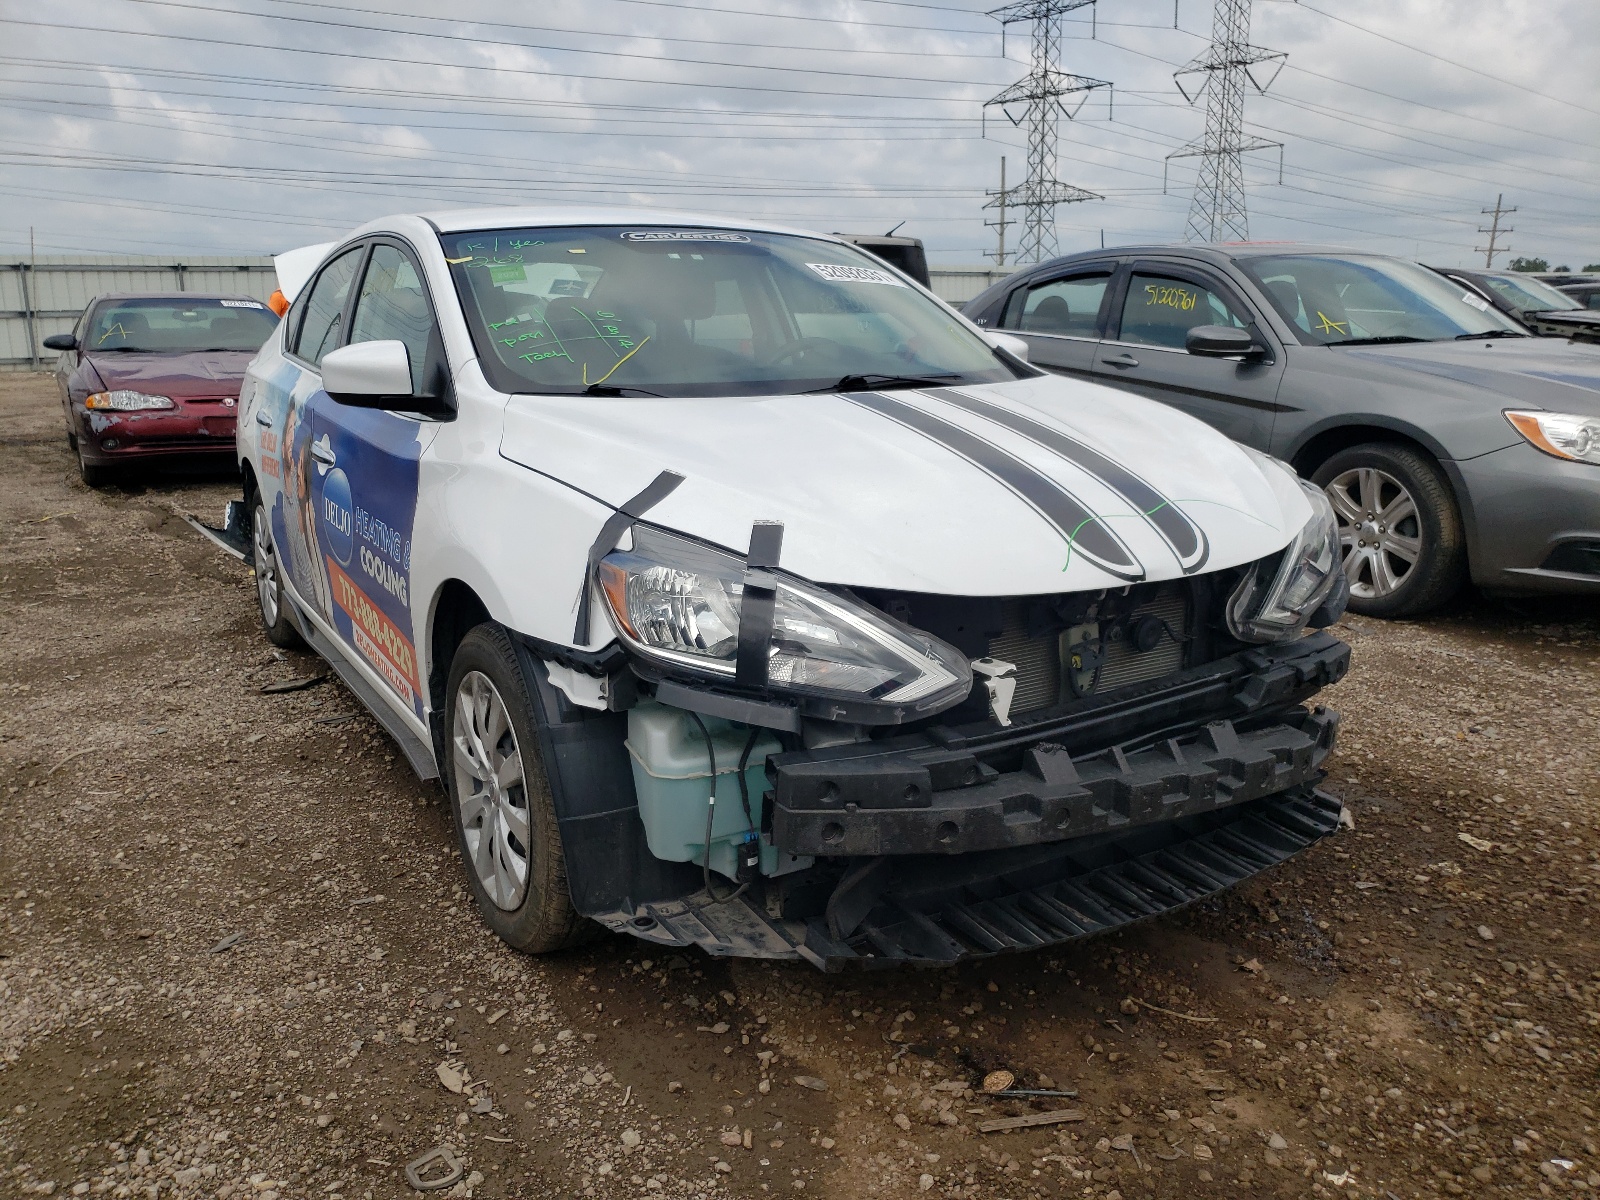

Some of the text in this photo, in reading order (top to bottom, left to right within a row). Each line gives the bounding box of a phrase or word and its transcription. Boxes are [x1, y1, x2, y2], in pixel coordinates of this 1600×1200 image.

[813, 264, 884, 282] 52092031
[324, 496, 352, 537] DELJO
[355, 506, 412, 572] HEATING &
[360, 545, 408, 607] COOLING
[338, 574, 414, 681] 773-888-4229
